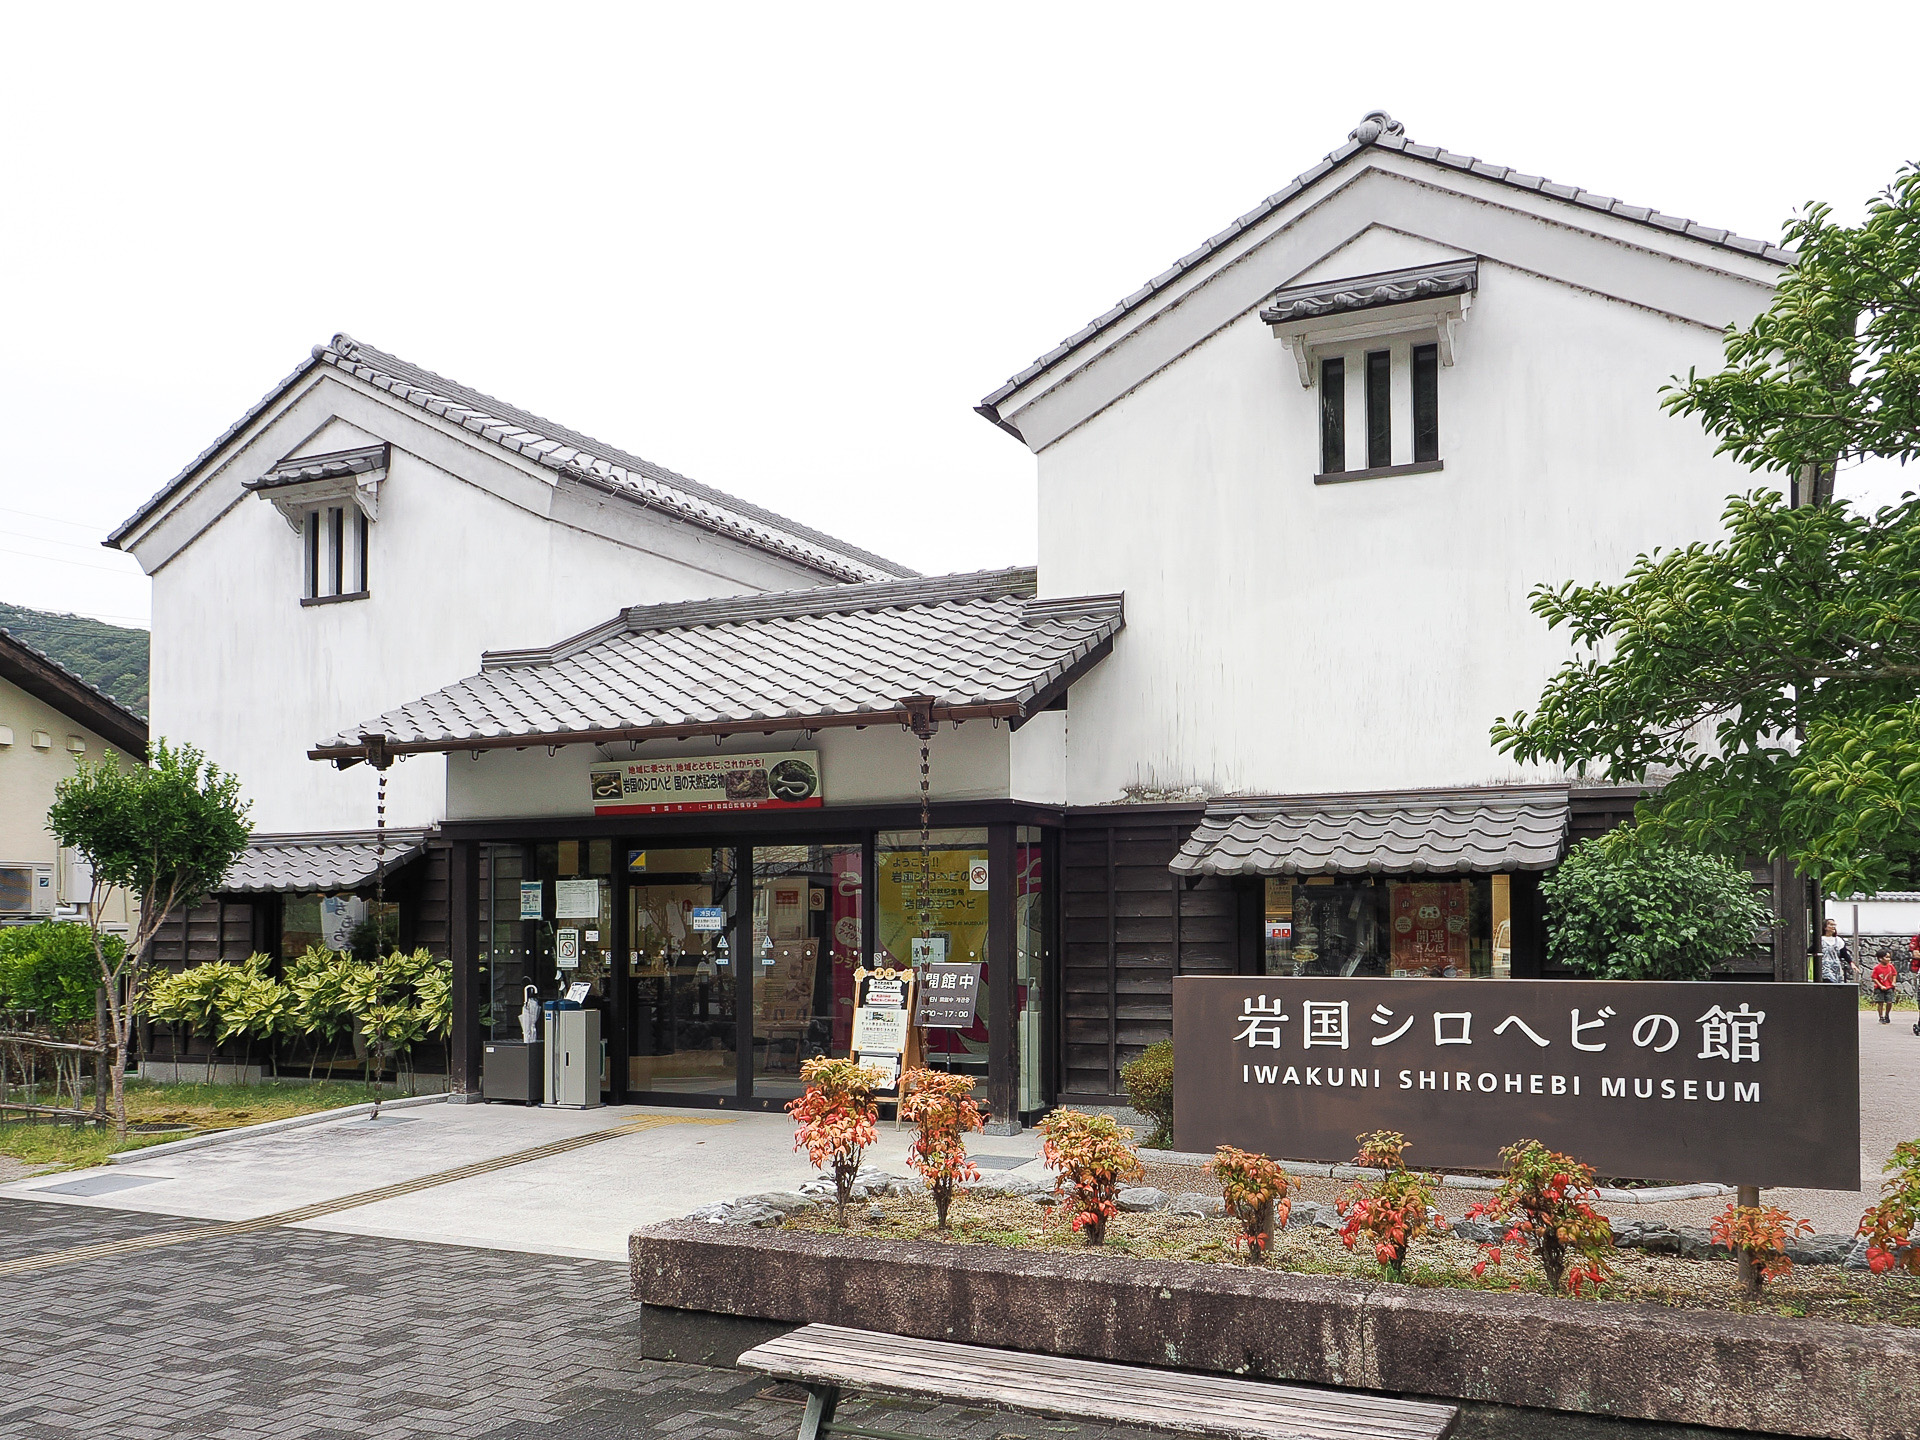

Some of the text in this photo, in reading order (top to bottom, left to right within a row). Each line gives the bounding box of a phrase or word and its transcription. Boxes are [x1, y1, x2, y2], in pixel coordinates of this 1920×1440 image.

[1233, 994, 1767, 1064] 岩国シロヘビの館
[1243, 1064, 1760, 1103] IWAKUNI SHIROHEBI MUSEUM
